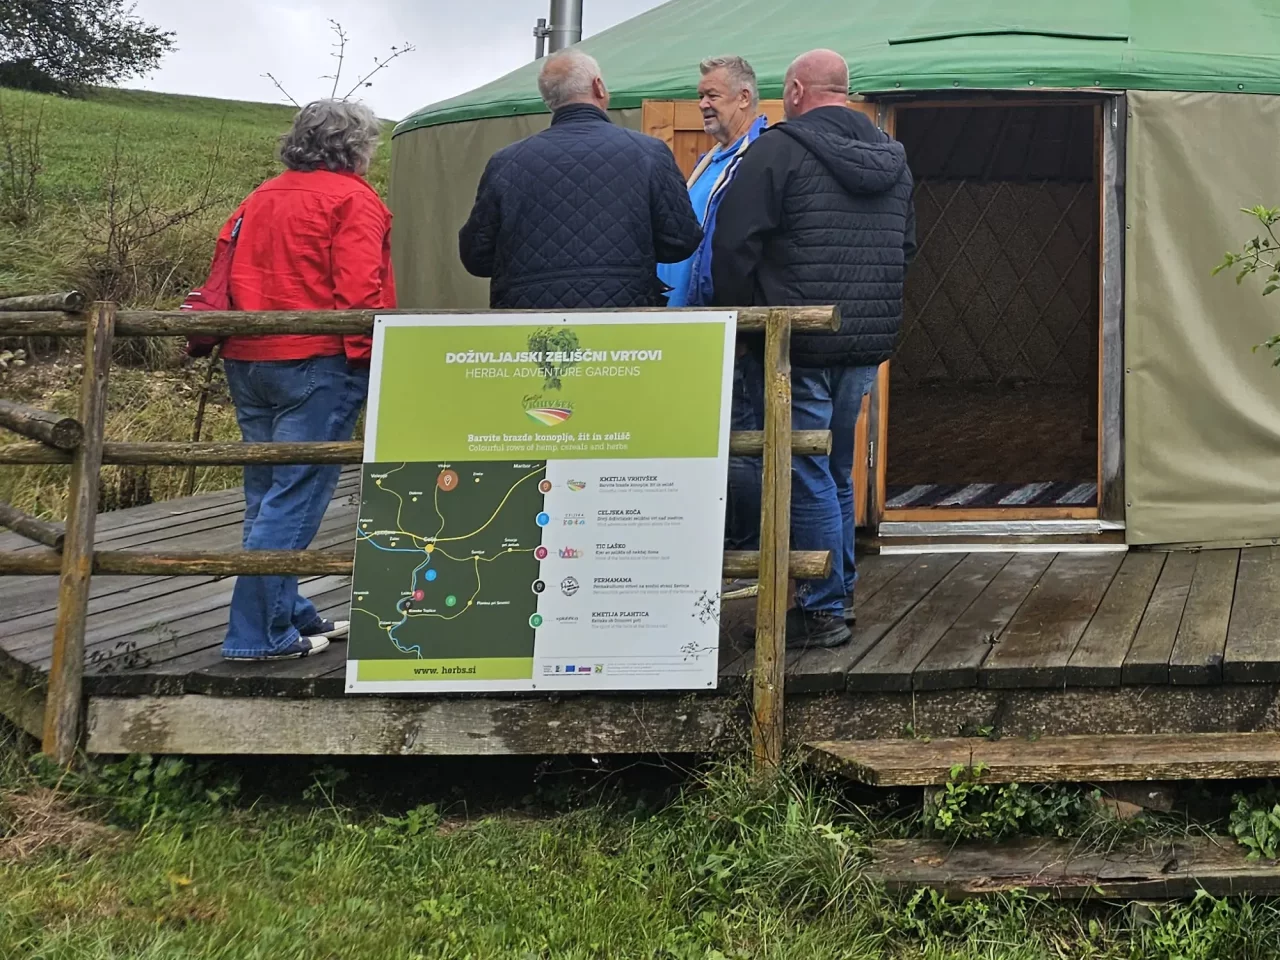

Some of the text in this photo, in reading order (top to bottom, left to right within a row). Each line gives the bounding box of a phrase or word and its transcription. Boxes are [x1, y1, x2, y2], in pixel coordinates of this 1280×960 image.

[445, 348, 662, 363] DOŽIVLJAJSKI ZELIŠČNI VRTOVI
[465, 365, 641, 378] HERBAL ADVENTURE GARDENS
[467, 434, 500, 442] Barvite
[503, 433, 532, 441] brazde
[592, 432, 602, 440] in
[468, 444, 504, 452] Colourful
[560, 443, 588, 451] cereals
[414, 665, 476, 675] www. herbs.si
